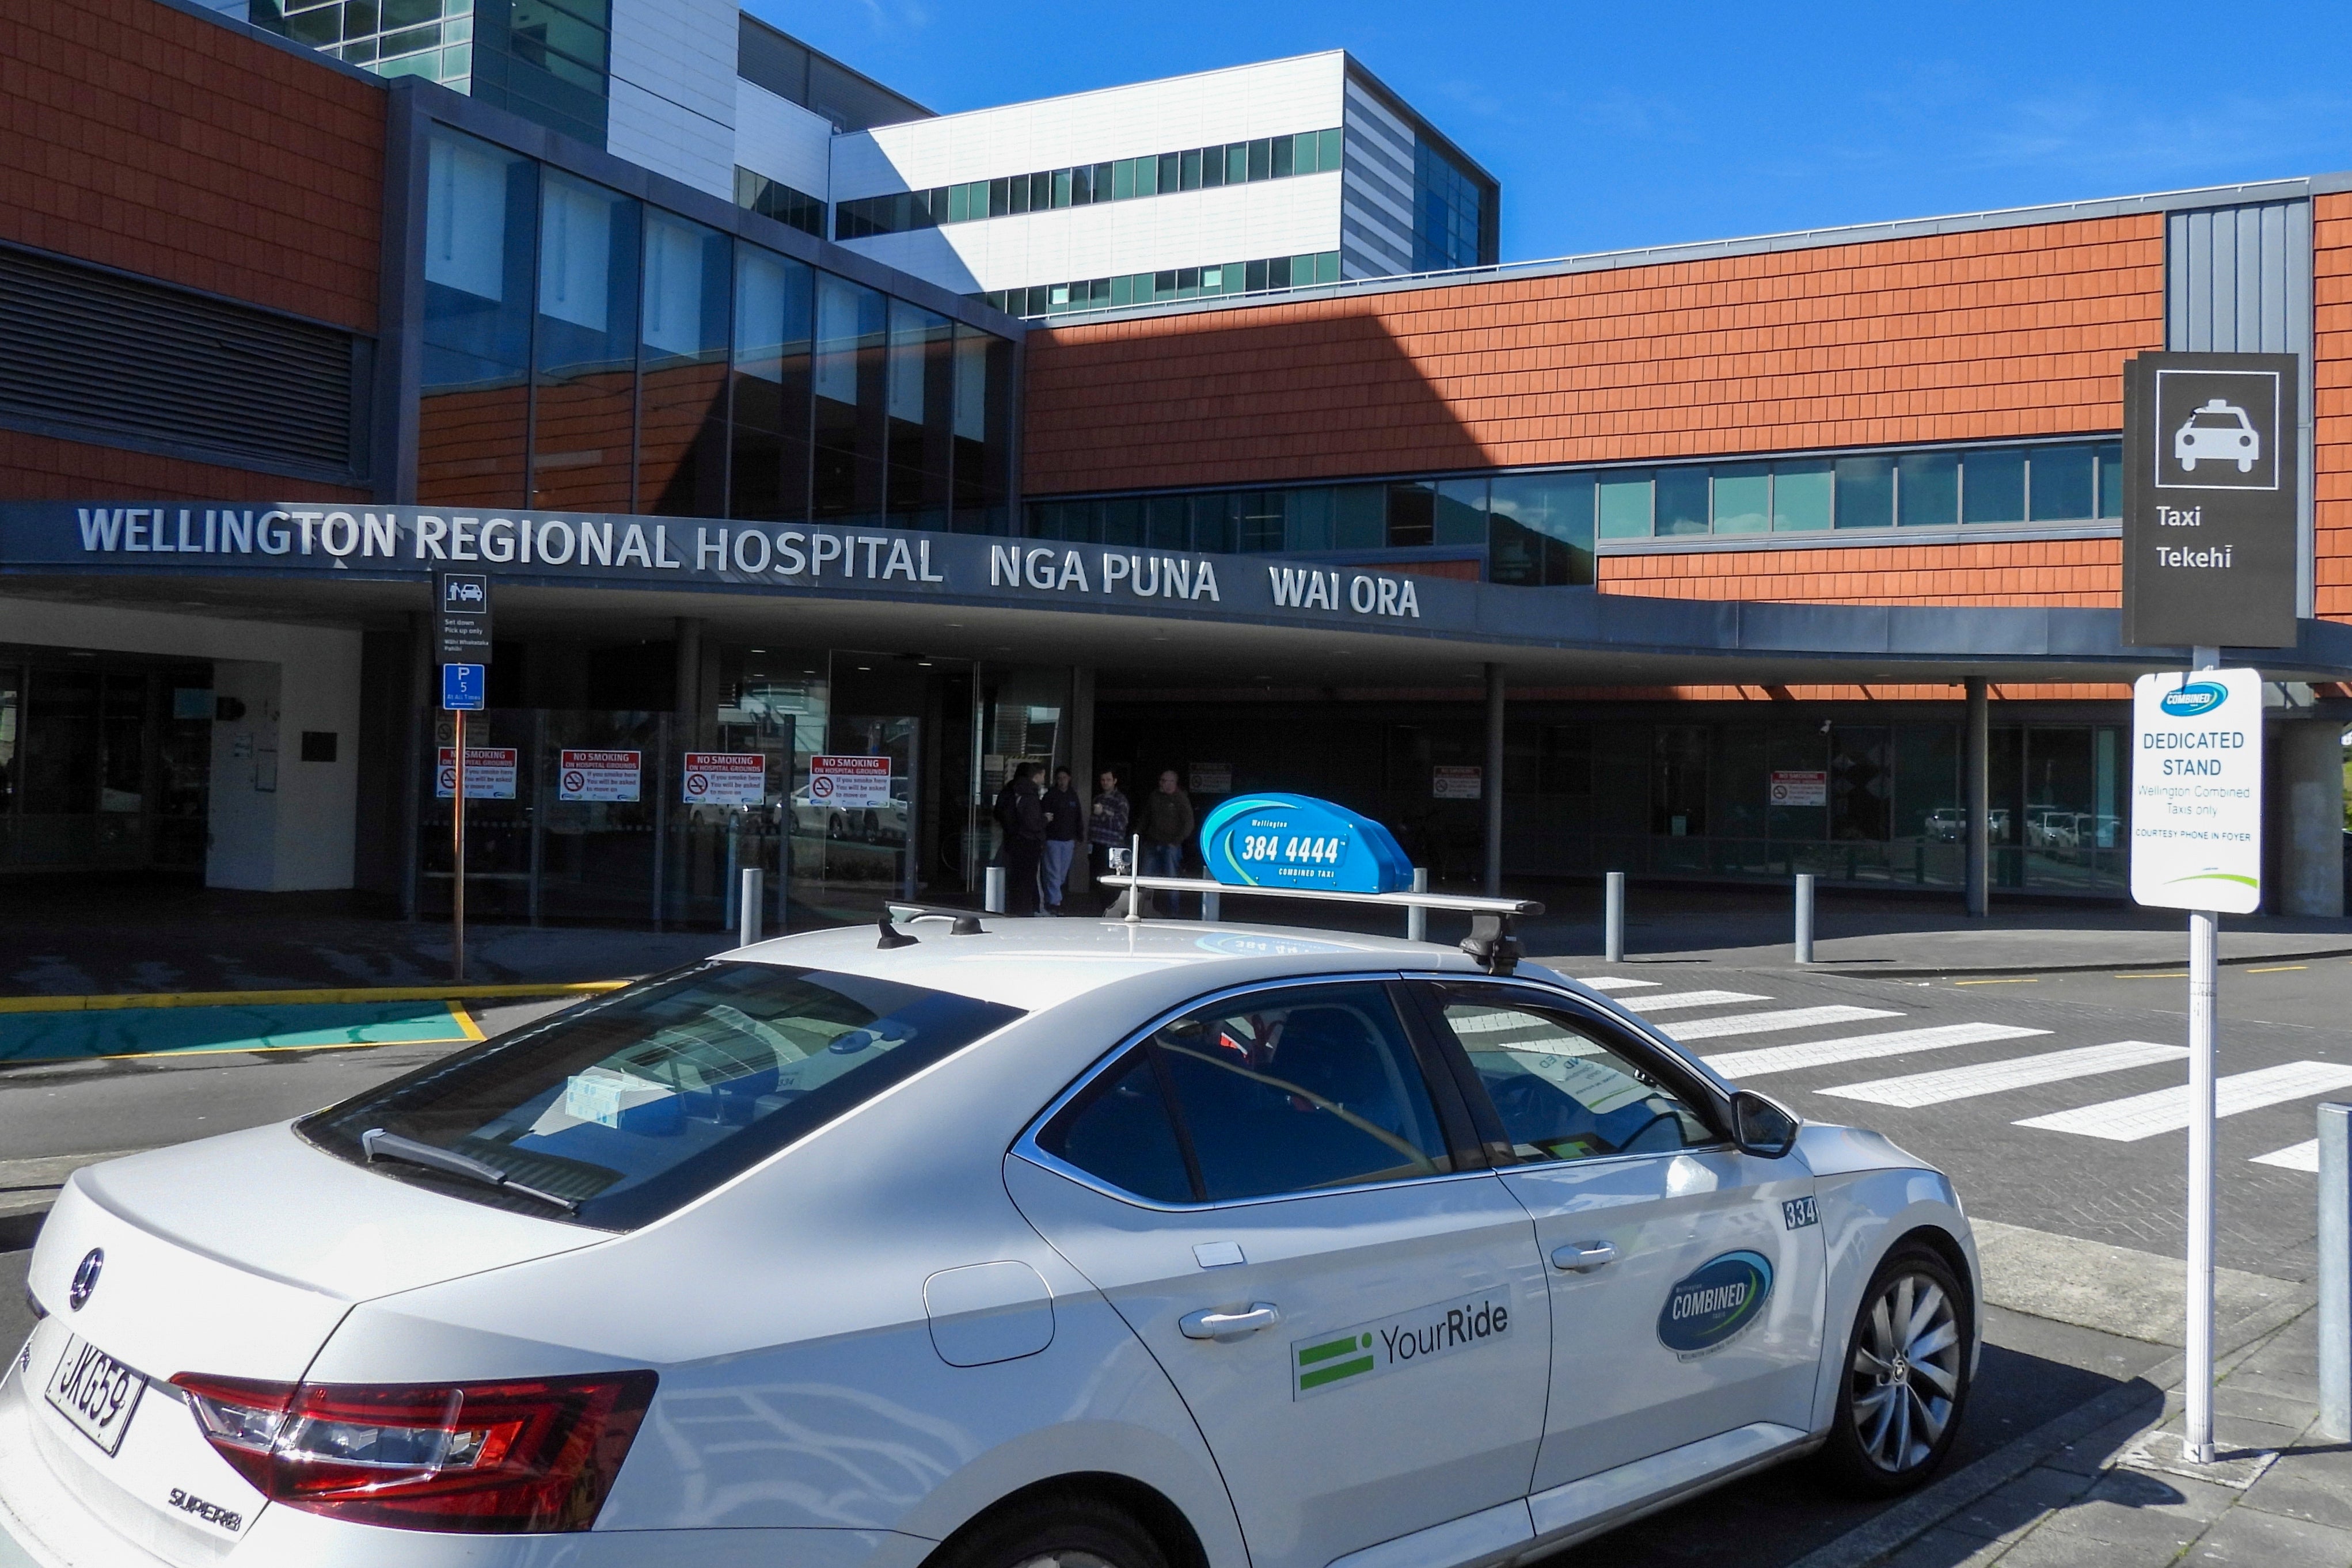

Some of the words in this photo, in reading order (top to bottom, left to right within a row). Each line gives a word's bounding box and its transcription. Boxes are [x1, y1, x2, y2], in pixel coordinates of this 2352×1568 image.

[2156, 506, 2201, 526] Taxi
[78, 508, 396, 557] WELLINGTON
[416, 515, 681, 569] REGIONAL
[697, 527, 944, 583] HOSPITAL
[2156, 545, 2233, 568] Tekehī
[991, 544, 1089, 592] NGA
[1103, 552, 1220, 602] PUNA
[1268, 566, 1340, 611] WAI
[1350, 575, 1420, 618] ORA
[458, 667, 470, 680] P
[461, 682, 467, 692] 5
[2167, 693, 2210, 705] COMBINED
[2144, 732, 2244, 749] DEDICATED
[465, 750, 505, 759] SMOKING
[573, 753, 586, 761] NO
[588, 753, 629, 762] SMOKING
[697, 756, 710, 764] NO
[712, 756, 753, 764] SMOKING
[837, 759, 879, 767] SMOKING
[2163, 759, 2221, 775] STAND
[2138, 785, 2190, 801] Wellington
[2194, 785, 2250, 798] Combined
[2167, 803, 2192, 815] Taxis
[2195, 805, 2217, 818] only
[1252, 819, 1287, 829] Wellington
[2136, 828, 2178, 839] COURTESY
[2180, 829, 2209, 840] PHONE
[2211, 831, 2219, 840] IN
[2221, 832, 2251, 842] FOYER
[1242, 835, 1279, 861] 384
[1285, 836, 1339, 864] 4444
[1278, 867, 1315, 878] COMBINED
[1317, 869, 1335, 878] TAXI
[1786, 1198, 1815, 1227] 334
[1672, 1282, 1745, 1320] COMBINED
[1380, 1300, 1507, 1364] YourRide
[60, 1342, 131, 1428] JKG59
[168, 1487, 242, 1532] SUPERB
